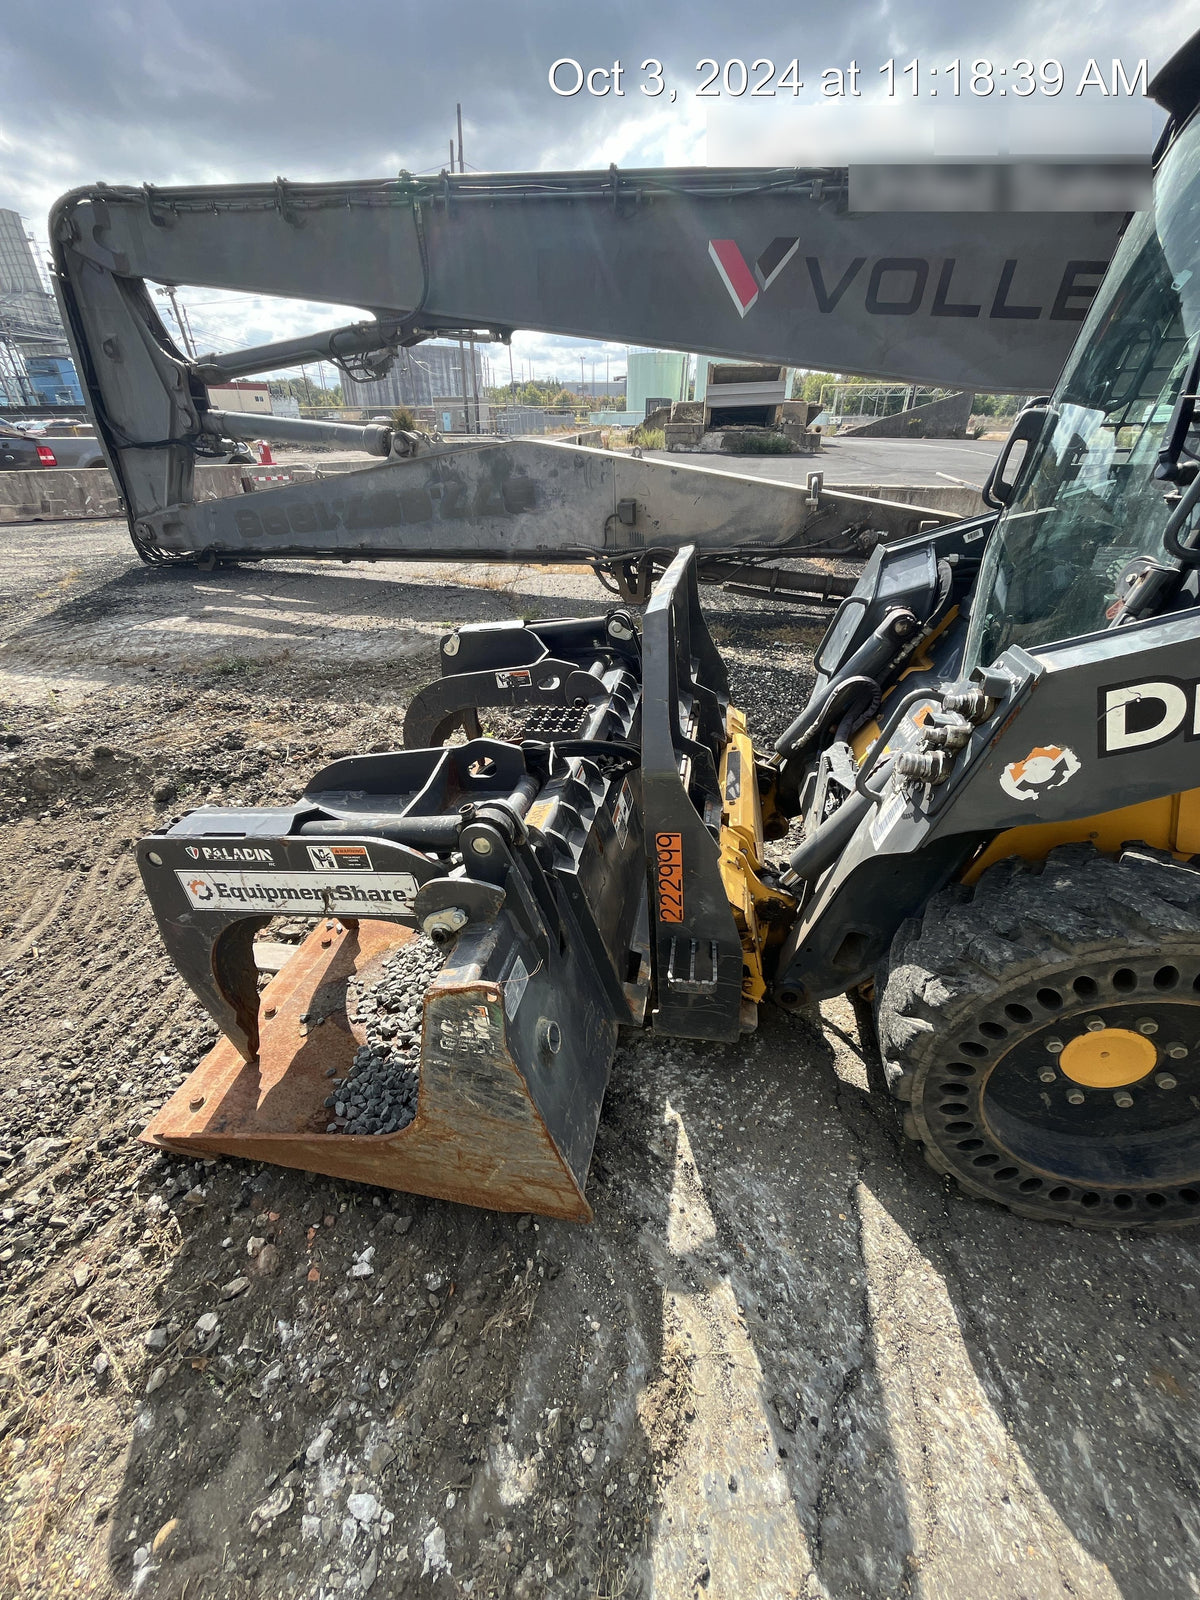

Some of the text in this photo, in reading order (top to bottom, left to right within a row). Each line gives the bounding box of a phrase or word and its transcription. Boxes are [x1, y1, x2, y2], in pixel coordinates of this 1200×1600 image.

[202, 847, 274, 862] PALADIN
[656, 834, 682, 922] 222999
[213, 882, 407, 902] EquipmentShare
